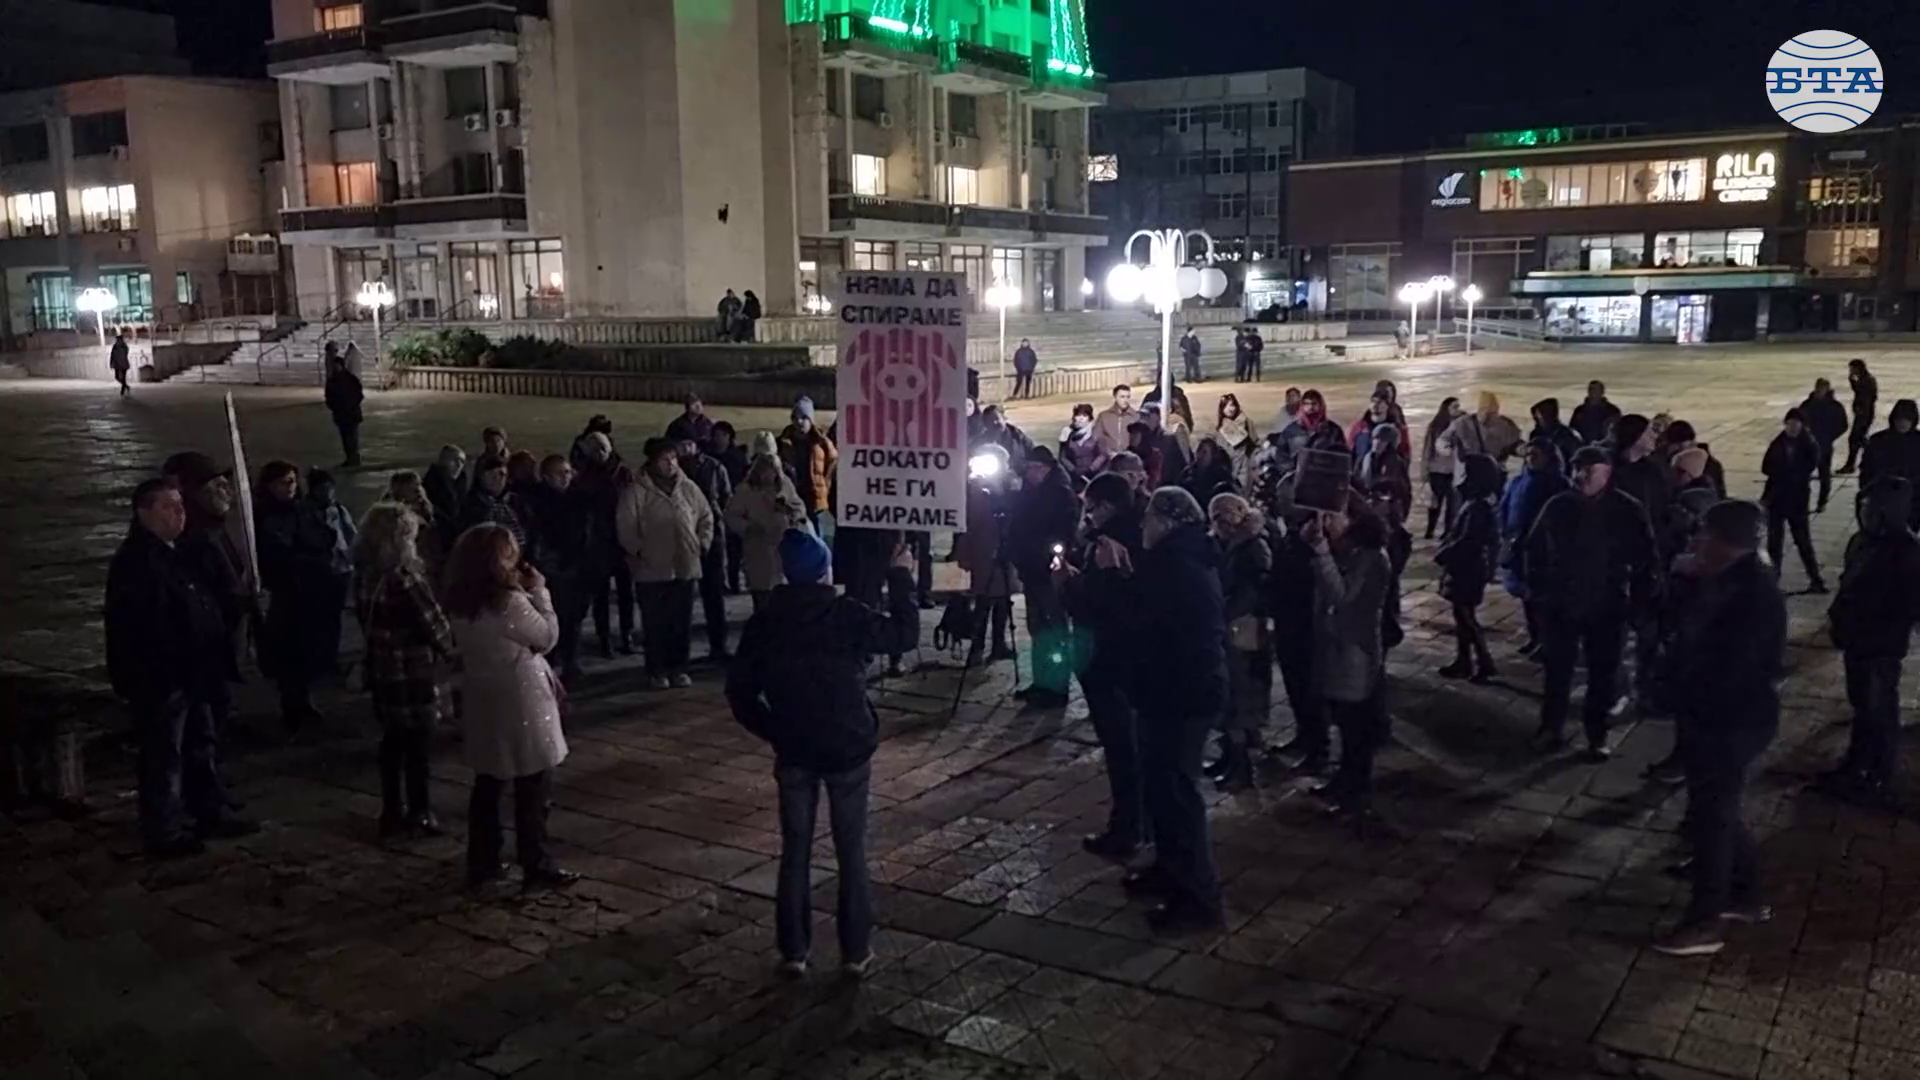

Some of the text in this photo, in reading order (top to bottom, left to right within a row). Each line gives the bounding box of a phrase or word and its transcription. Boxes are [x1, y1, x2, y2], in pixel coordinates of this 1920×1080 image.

[1716, 152, 1775, 177] RILA
[845, 276, 957, 298] НЯМА ДА
[841, 305, 961, 326] СПИРАМЕ
[851, 449, 950, 470] ДОКАТО
[866, 477, 936, 498] НЕ ГИ
[845, 503, 958, 527] РАИРАМЕ
